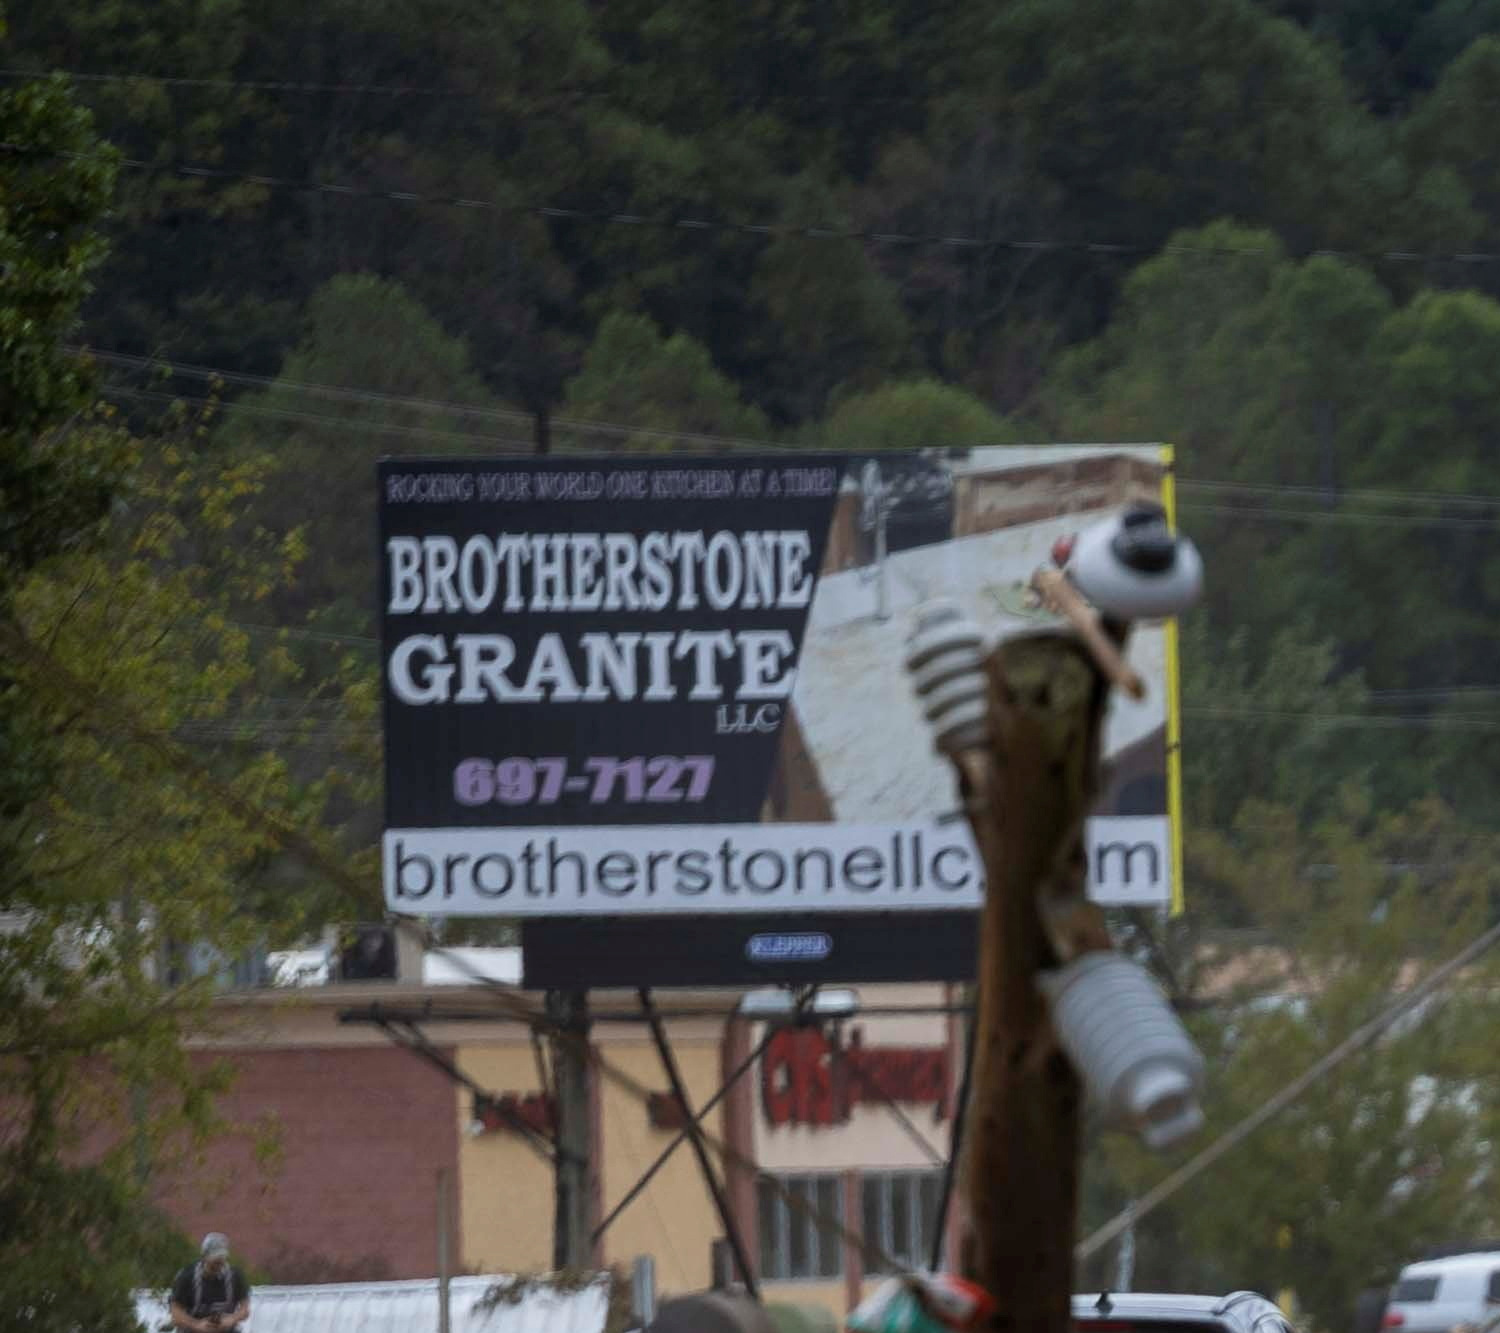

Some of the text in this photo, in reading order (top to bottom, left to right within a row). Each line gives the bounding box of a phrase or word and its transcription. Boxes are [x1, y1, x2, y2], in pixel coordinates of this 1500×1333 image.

[387, 473, 474, 502] ROCKING
[477, 472, 532, 500] YOUR
[534, 471, 602, 500] WORLD
[605, 470, 649, 499] ONE
[652, 469, 735, 498] KITCHEN
[738, 468, 763, 497] AT
[765, 468, 781, 497] A
[387, 529, 813, 616] BROTHERSTONE
[388, 629, 798, 704] GRANITE
[717, 702, 782, 734] LLC
[454, 755, 715, 804] 697-7127
[394, 830, 1161, 899] brotherstonellc.m
